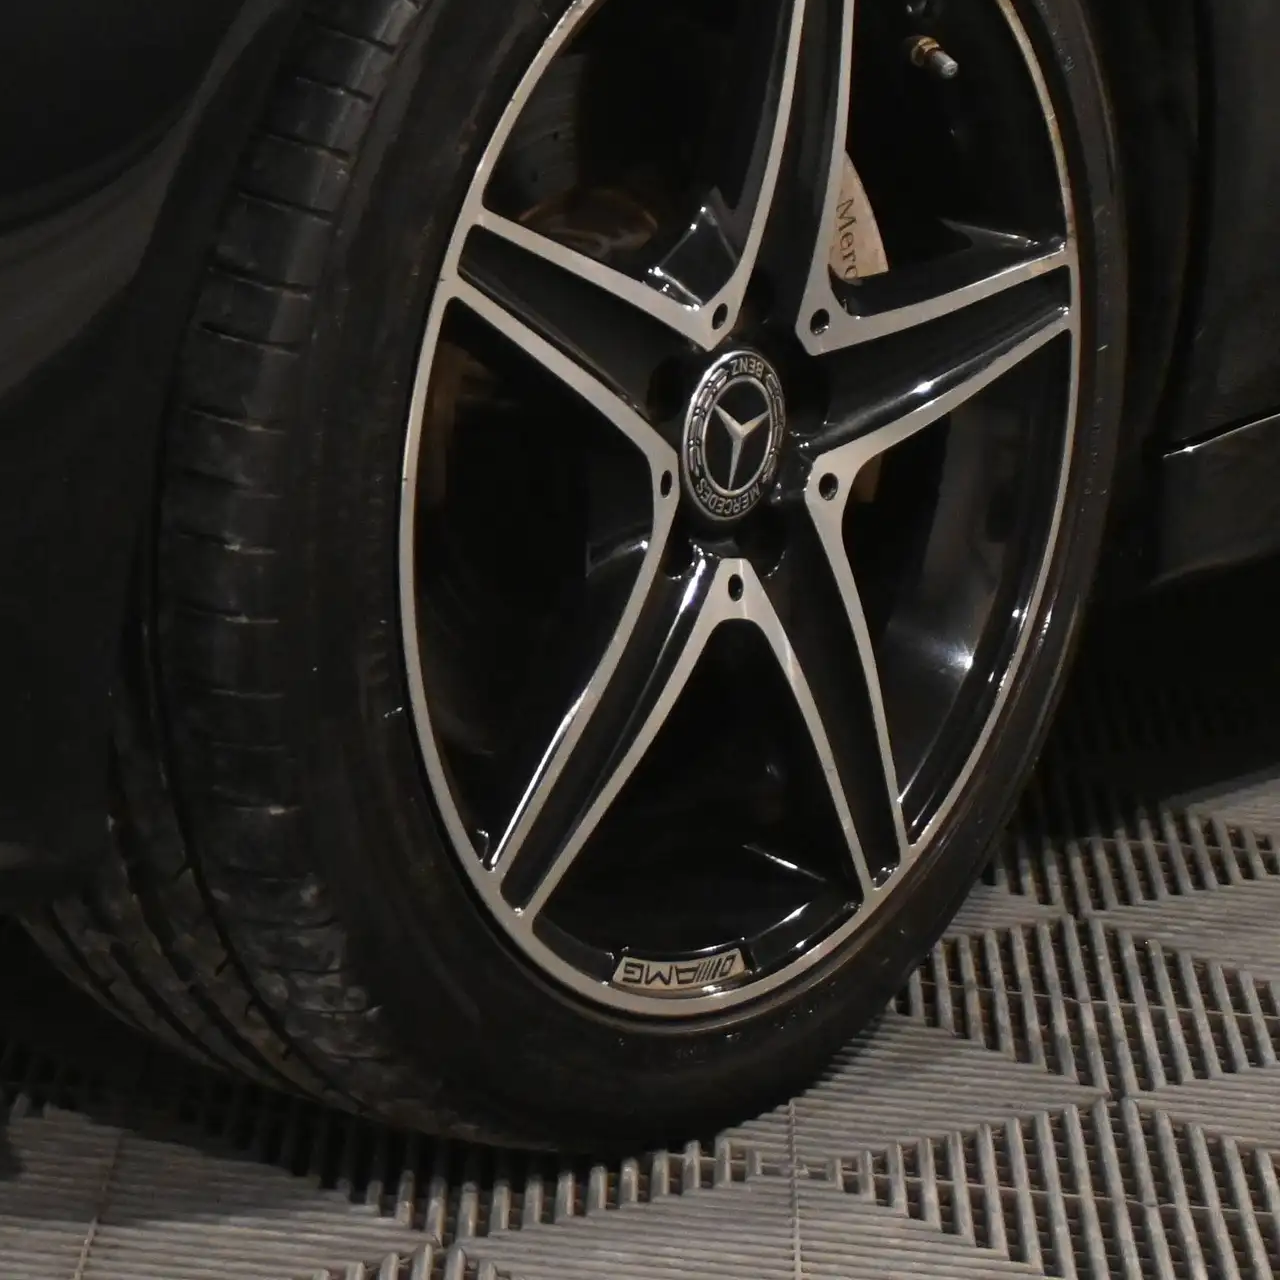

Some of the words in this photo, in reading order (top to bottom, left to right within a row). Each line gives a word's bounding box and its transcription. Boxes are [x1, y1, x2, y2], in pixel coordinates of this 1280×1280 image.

[728, 356, 765, 378] BENZ
[695, 477, 761, 515] MERCEDES
[622, 960, 700, 985] AMG
